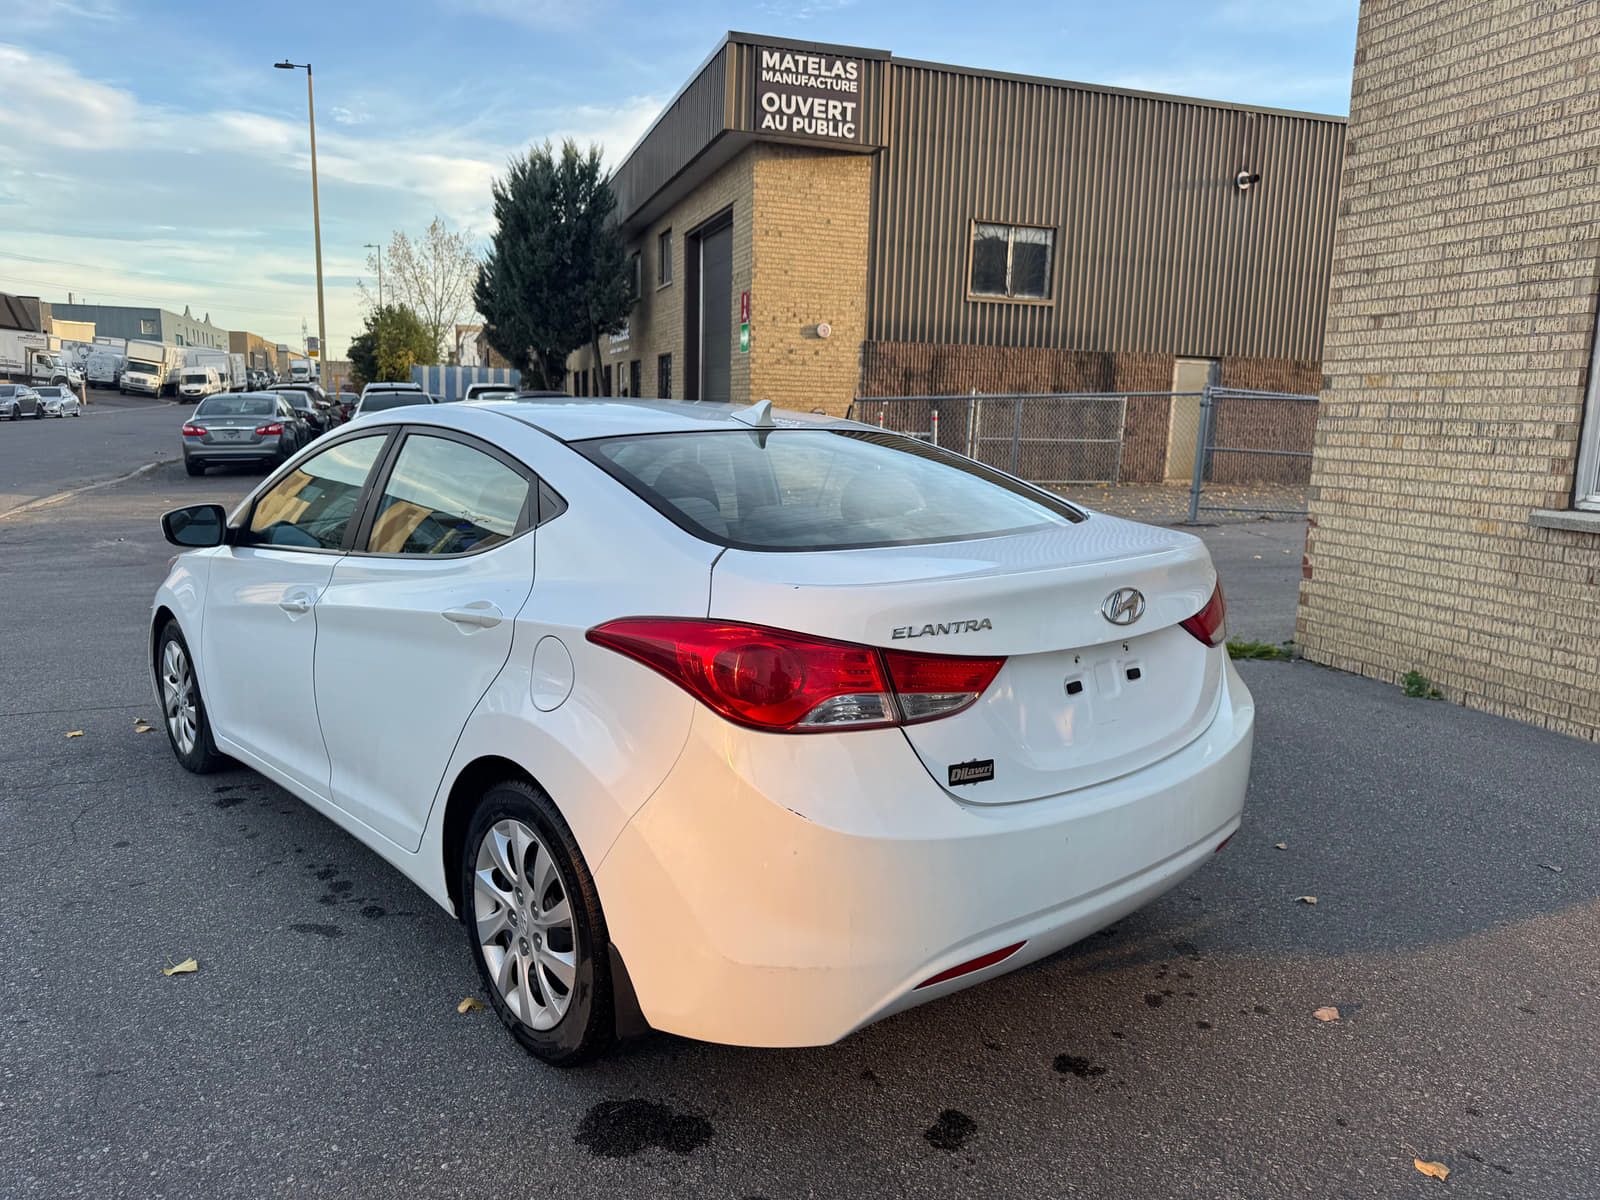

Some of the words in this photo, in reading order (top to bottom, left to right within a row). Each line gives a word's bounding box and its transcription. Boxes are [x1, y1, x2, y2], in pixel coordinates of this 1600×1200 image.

[762, 50, 858, 80] MATELAS
[761, 70, 858, 93] MANUFACTURE
[761, 92, 857, 121] OUVERT
[761, 114, 788, 131] AU
[792, 117, 856, 139] PUBLIC
[892, 618, 993, 640] ELANTRA
